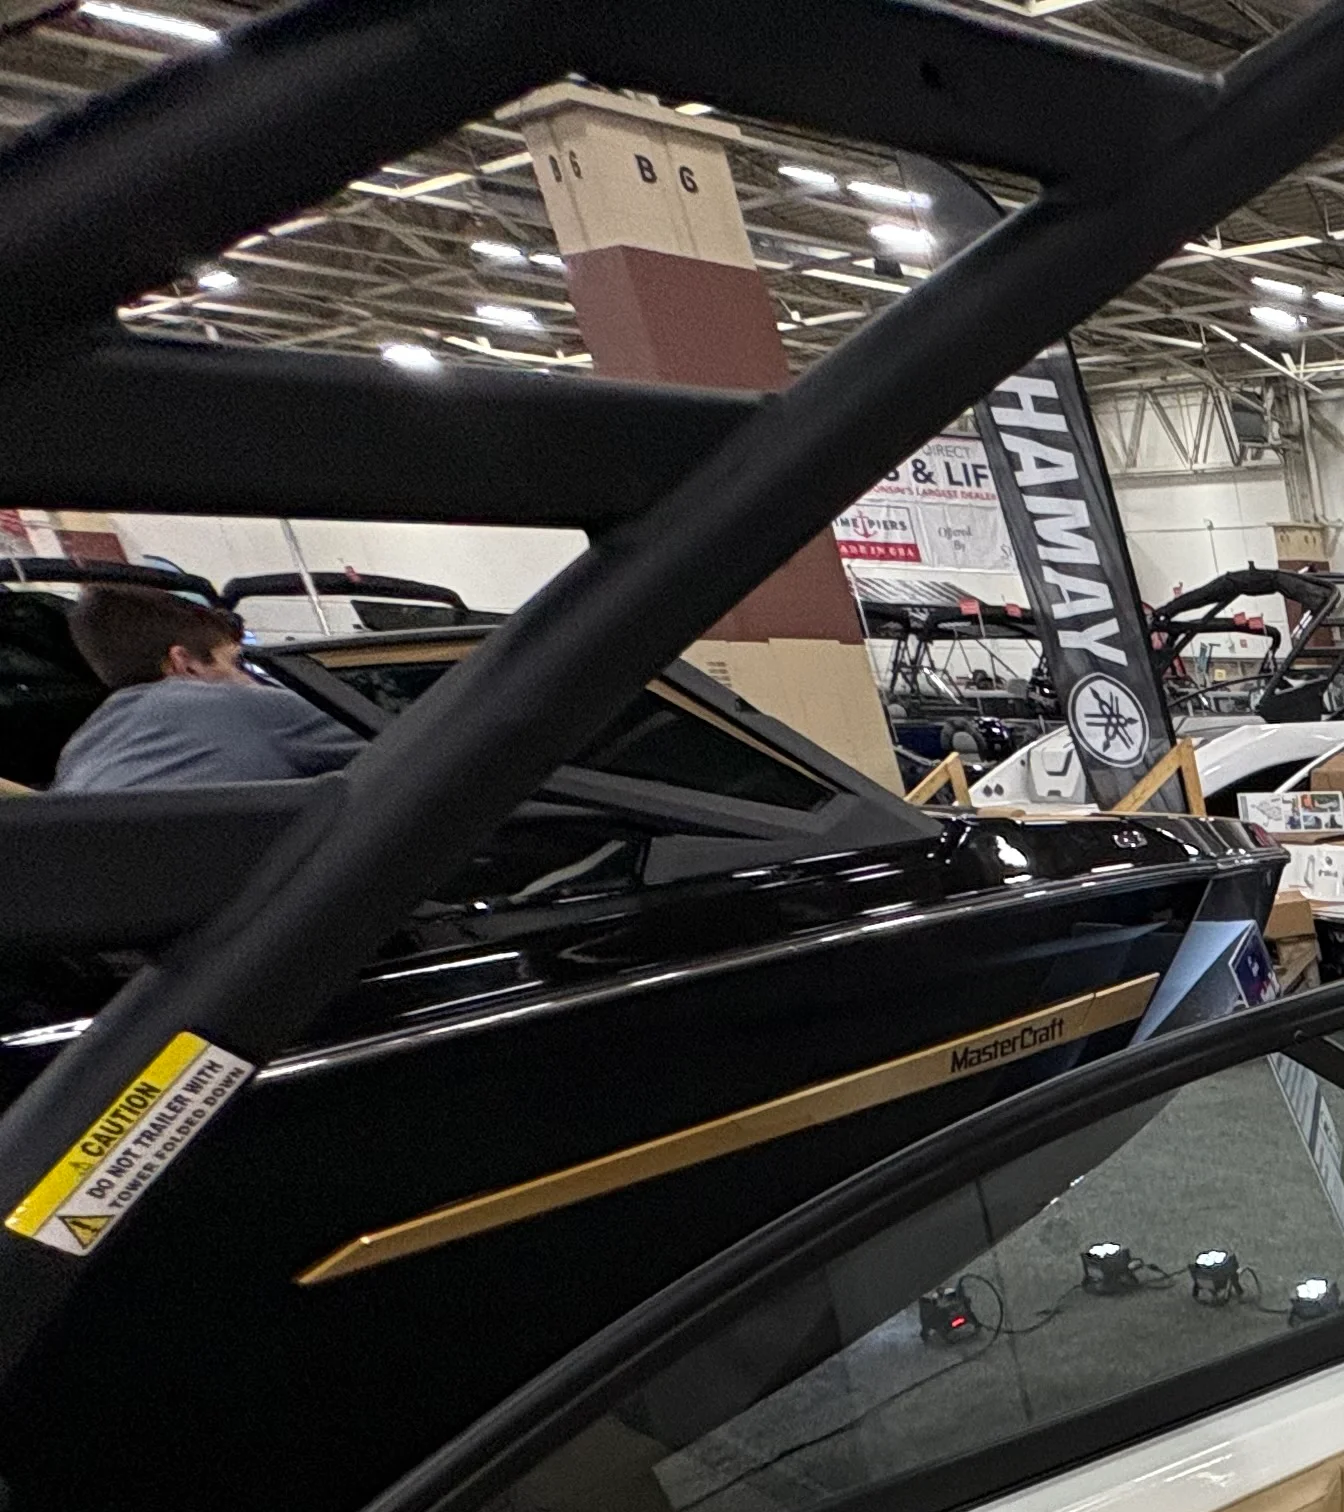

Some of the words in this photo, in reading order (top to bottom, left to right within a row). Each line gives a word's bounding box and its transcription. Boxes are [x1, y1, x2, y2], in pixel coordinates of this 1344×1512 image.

[634, 153, 658, 184] B
[678, 165, 699, 194] 6
[911, 458, 938, 486] &
[944, 461, 990, 489] LIF
[867, 518, 908, 532] PIERS
[950, 1017, 1065, 1074] MasterCraft
[80, 1081, 162, 1158] CAUTION
[86, 1175, 113, 1200] DO
[106, 1146, 142, 1180] NOT
[133, 1093, 192, 1151] TRAILER
[183, 1059, 225, 1095] WITH
[108, 1162, 160, 1210] TOWER
[155, 1108, 207, 1161] FOLDED
[205, 1066, 246, 1107] DOWN
